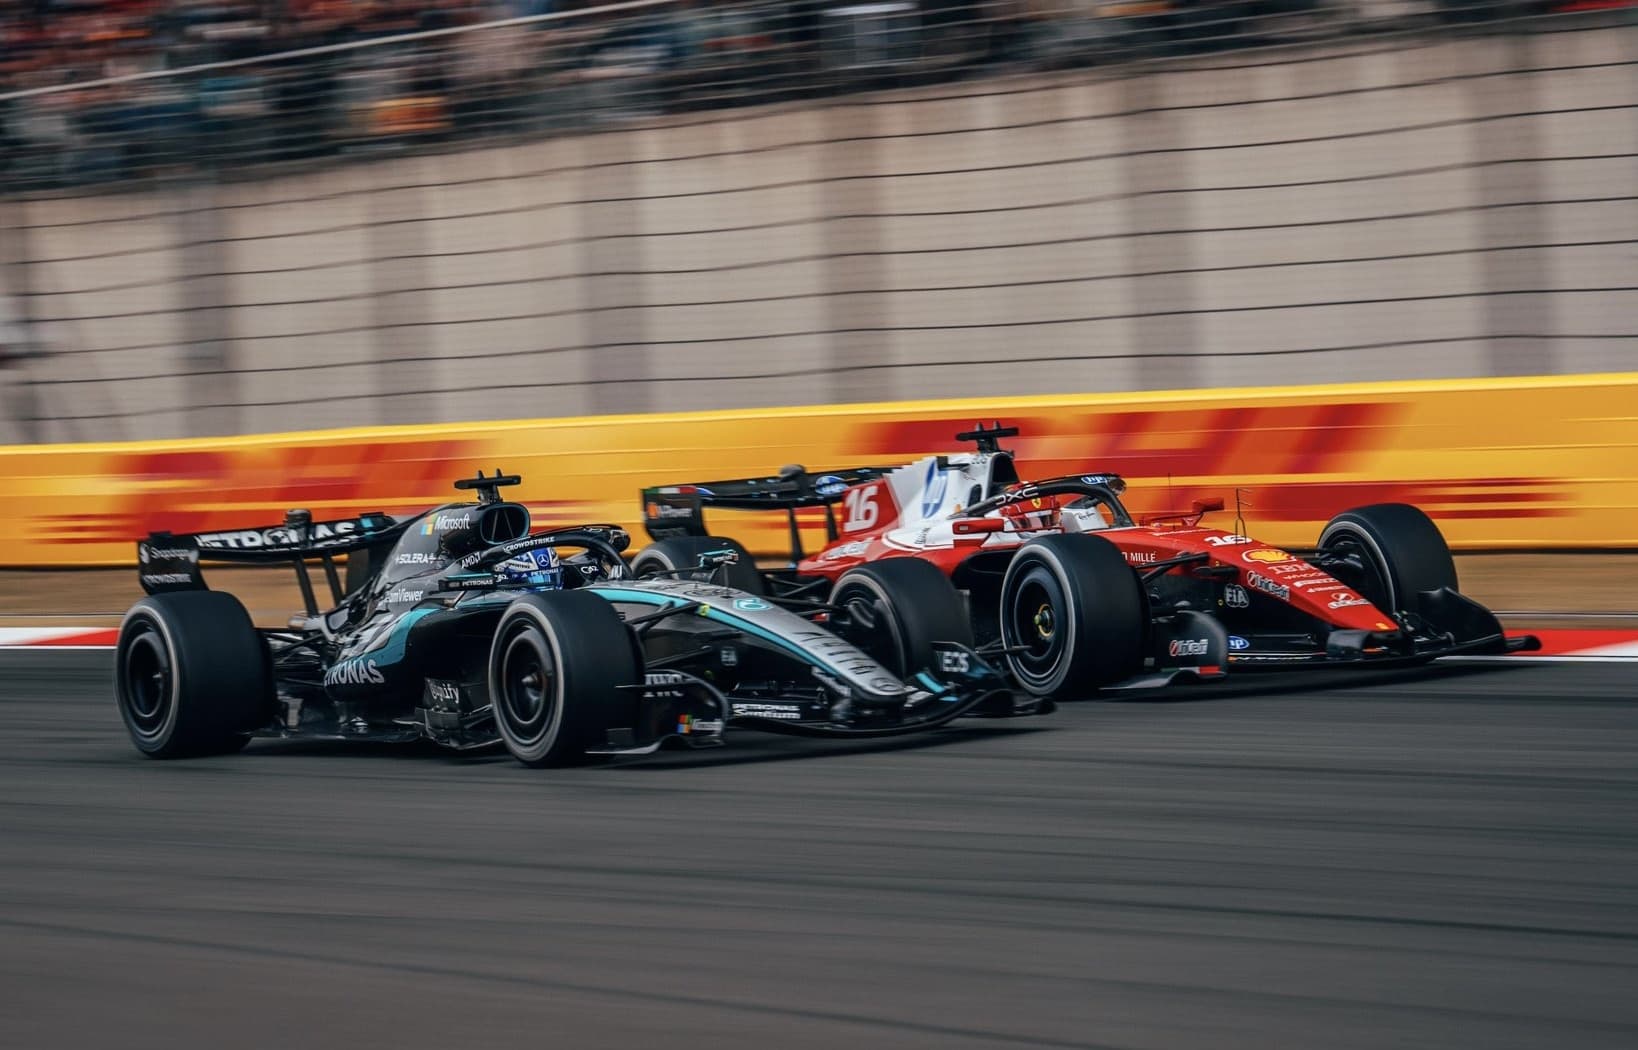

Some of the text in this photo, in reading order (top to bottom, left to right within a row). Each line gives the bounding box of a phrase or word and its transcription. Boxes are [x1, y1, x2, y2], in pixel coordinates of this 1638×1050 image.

[994, 486, 1039, 505] DXC
[842, 485, 879, 532] 16
[434, 513, 470, 530] Microsoft
[504, 537, 555, 552] CROWDSTRIKE
[1204, 535, 1253, 546] 16
[461, 554, 477, 568] AMD
[1130, 551, 1156, 562] MILLE
[462, 579, 493, 587] PETRONAS
[1226, 588, 1245, 602] FIA
